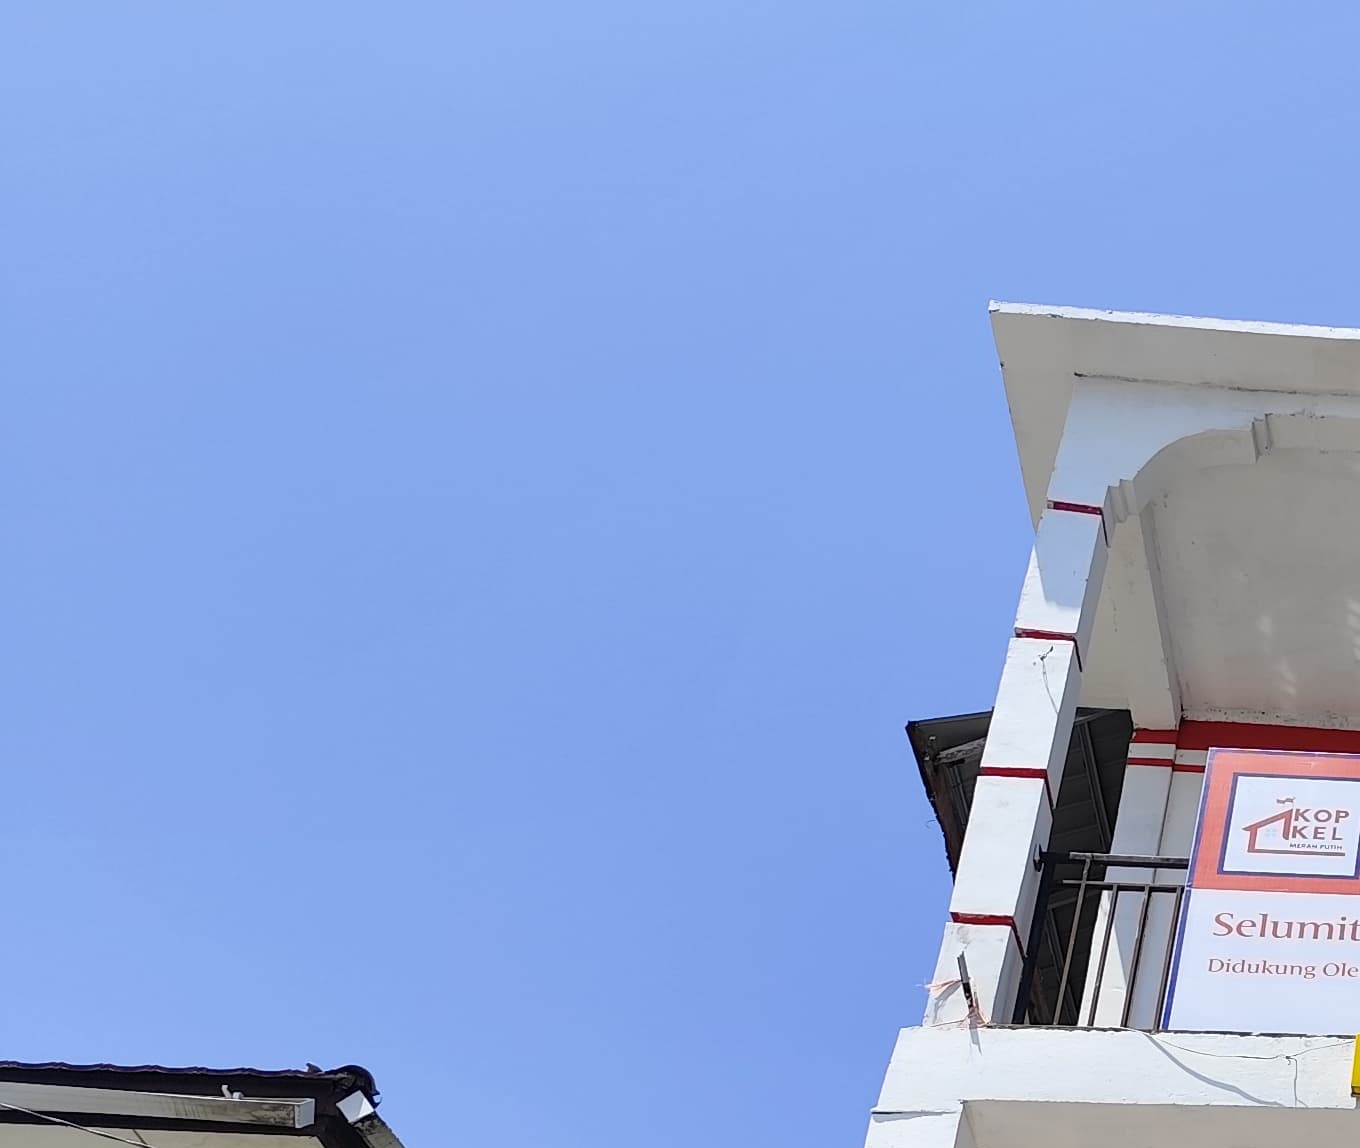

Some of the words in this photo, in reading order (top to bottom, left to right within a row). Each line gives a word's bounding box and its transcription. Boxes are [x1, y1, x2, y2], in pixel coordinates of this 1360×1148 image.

[1294, 808, 1350, 824] KOP
[1291, 825, 1343, 841] KEL
[1207, 958, 1316, 980] Didukung
